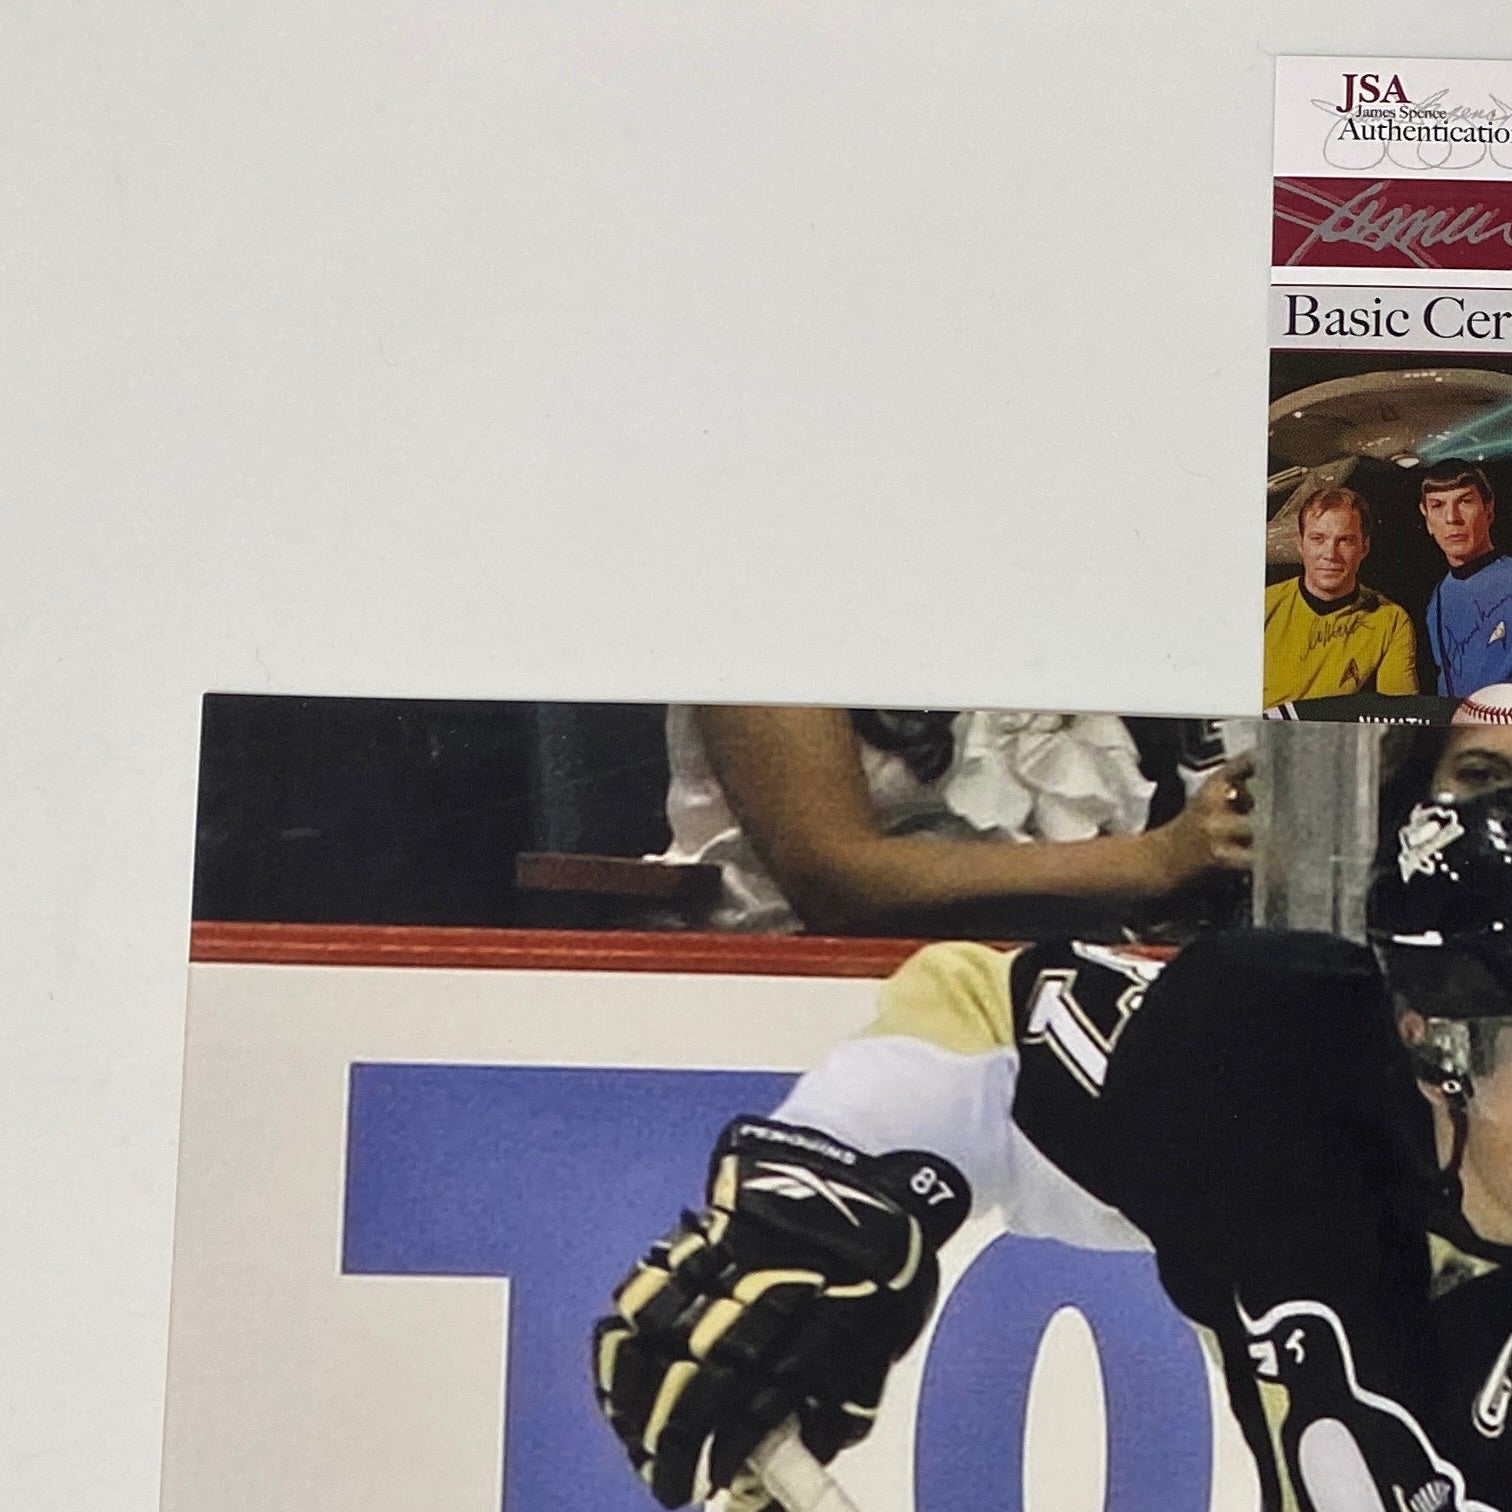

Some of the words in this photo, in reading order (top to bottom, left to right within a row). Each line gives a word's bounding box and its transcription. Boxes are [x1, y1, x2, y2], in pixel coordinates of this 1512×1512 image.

[1336, 74, 1412, 113] JSA
[1355, 105, 1396, 119] James
[1400, 105, 1447, 119] Spence
[1284, 295, 1409, 337] Basic
[909, 1165, 955, 1206] 87
